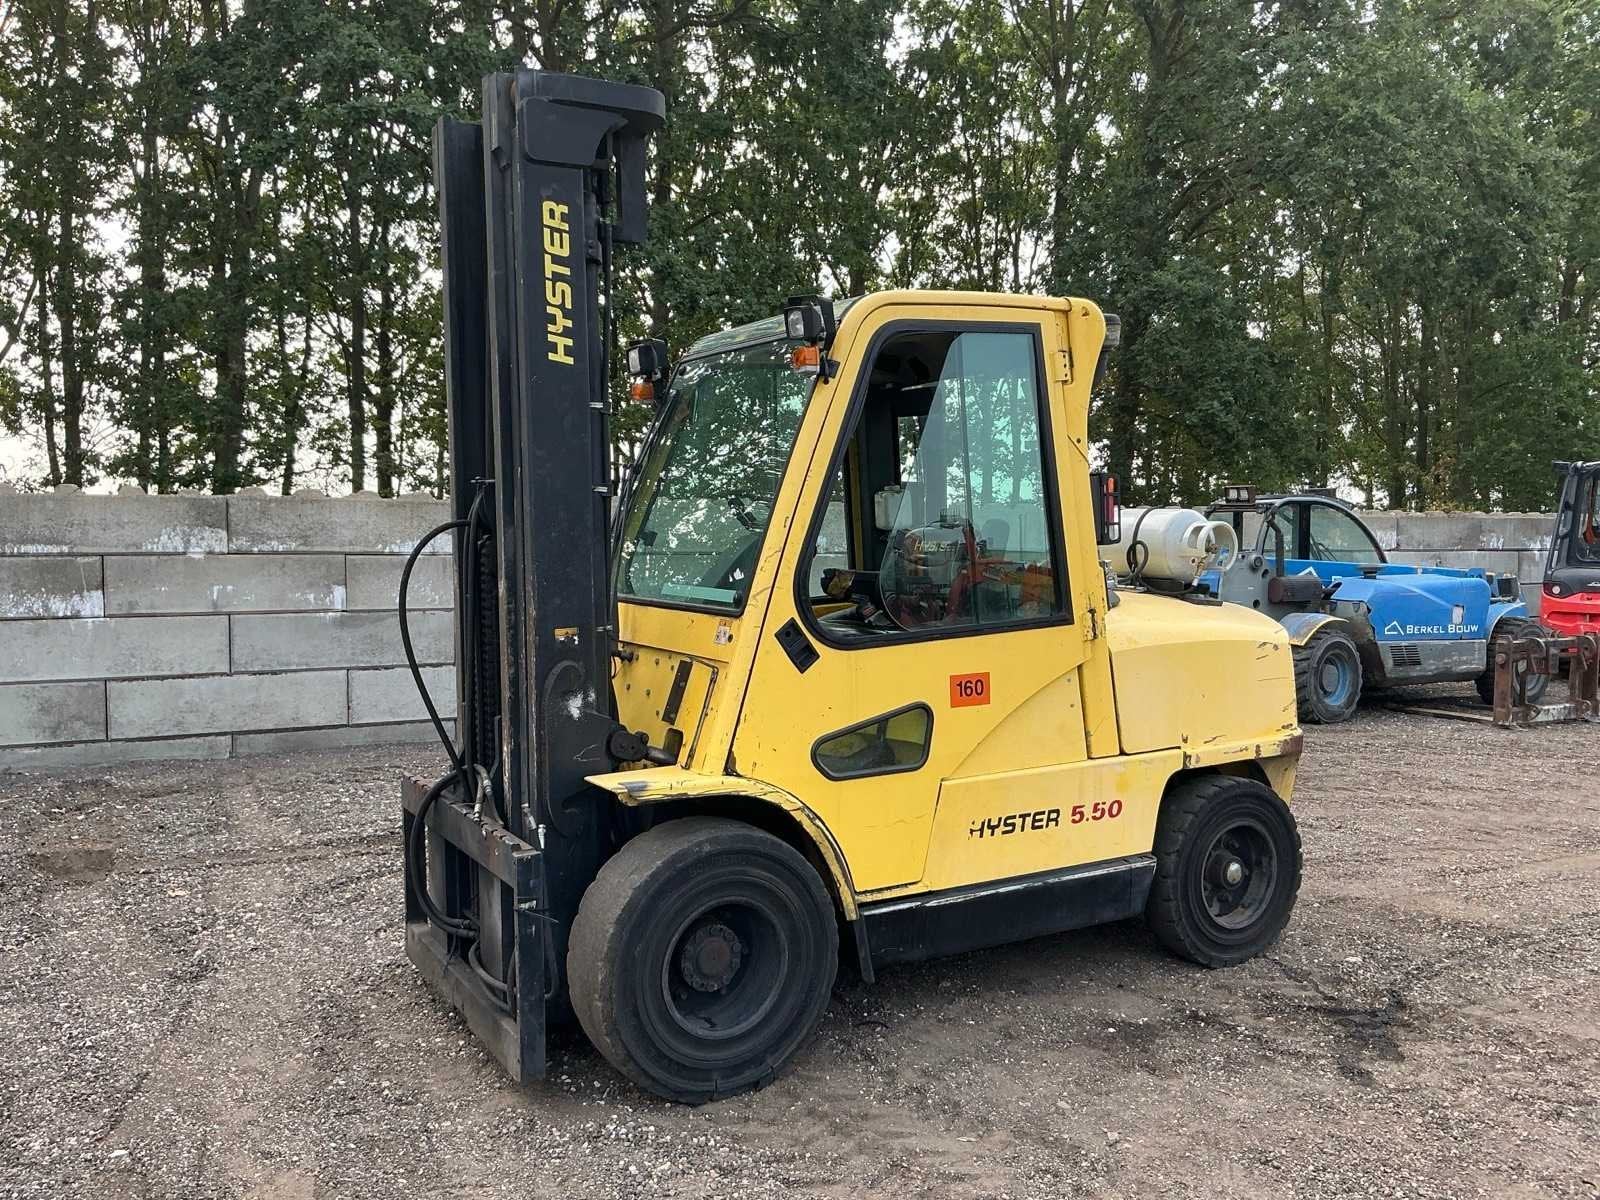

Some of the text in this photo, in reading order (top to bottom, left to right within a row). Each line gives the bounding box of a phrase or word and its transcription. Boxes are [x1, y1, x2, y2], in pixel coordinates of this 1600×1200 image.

[542, 200, 574, 365] HYSTER
[1406, 623, 1479, 634] BERKEL BOUW
[956, 679, 984, 697] 160
[968, 799, 1123, 840] HYSTER 5.50
